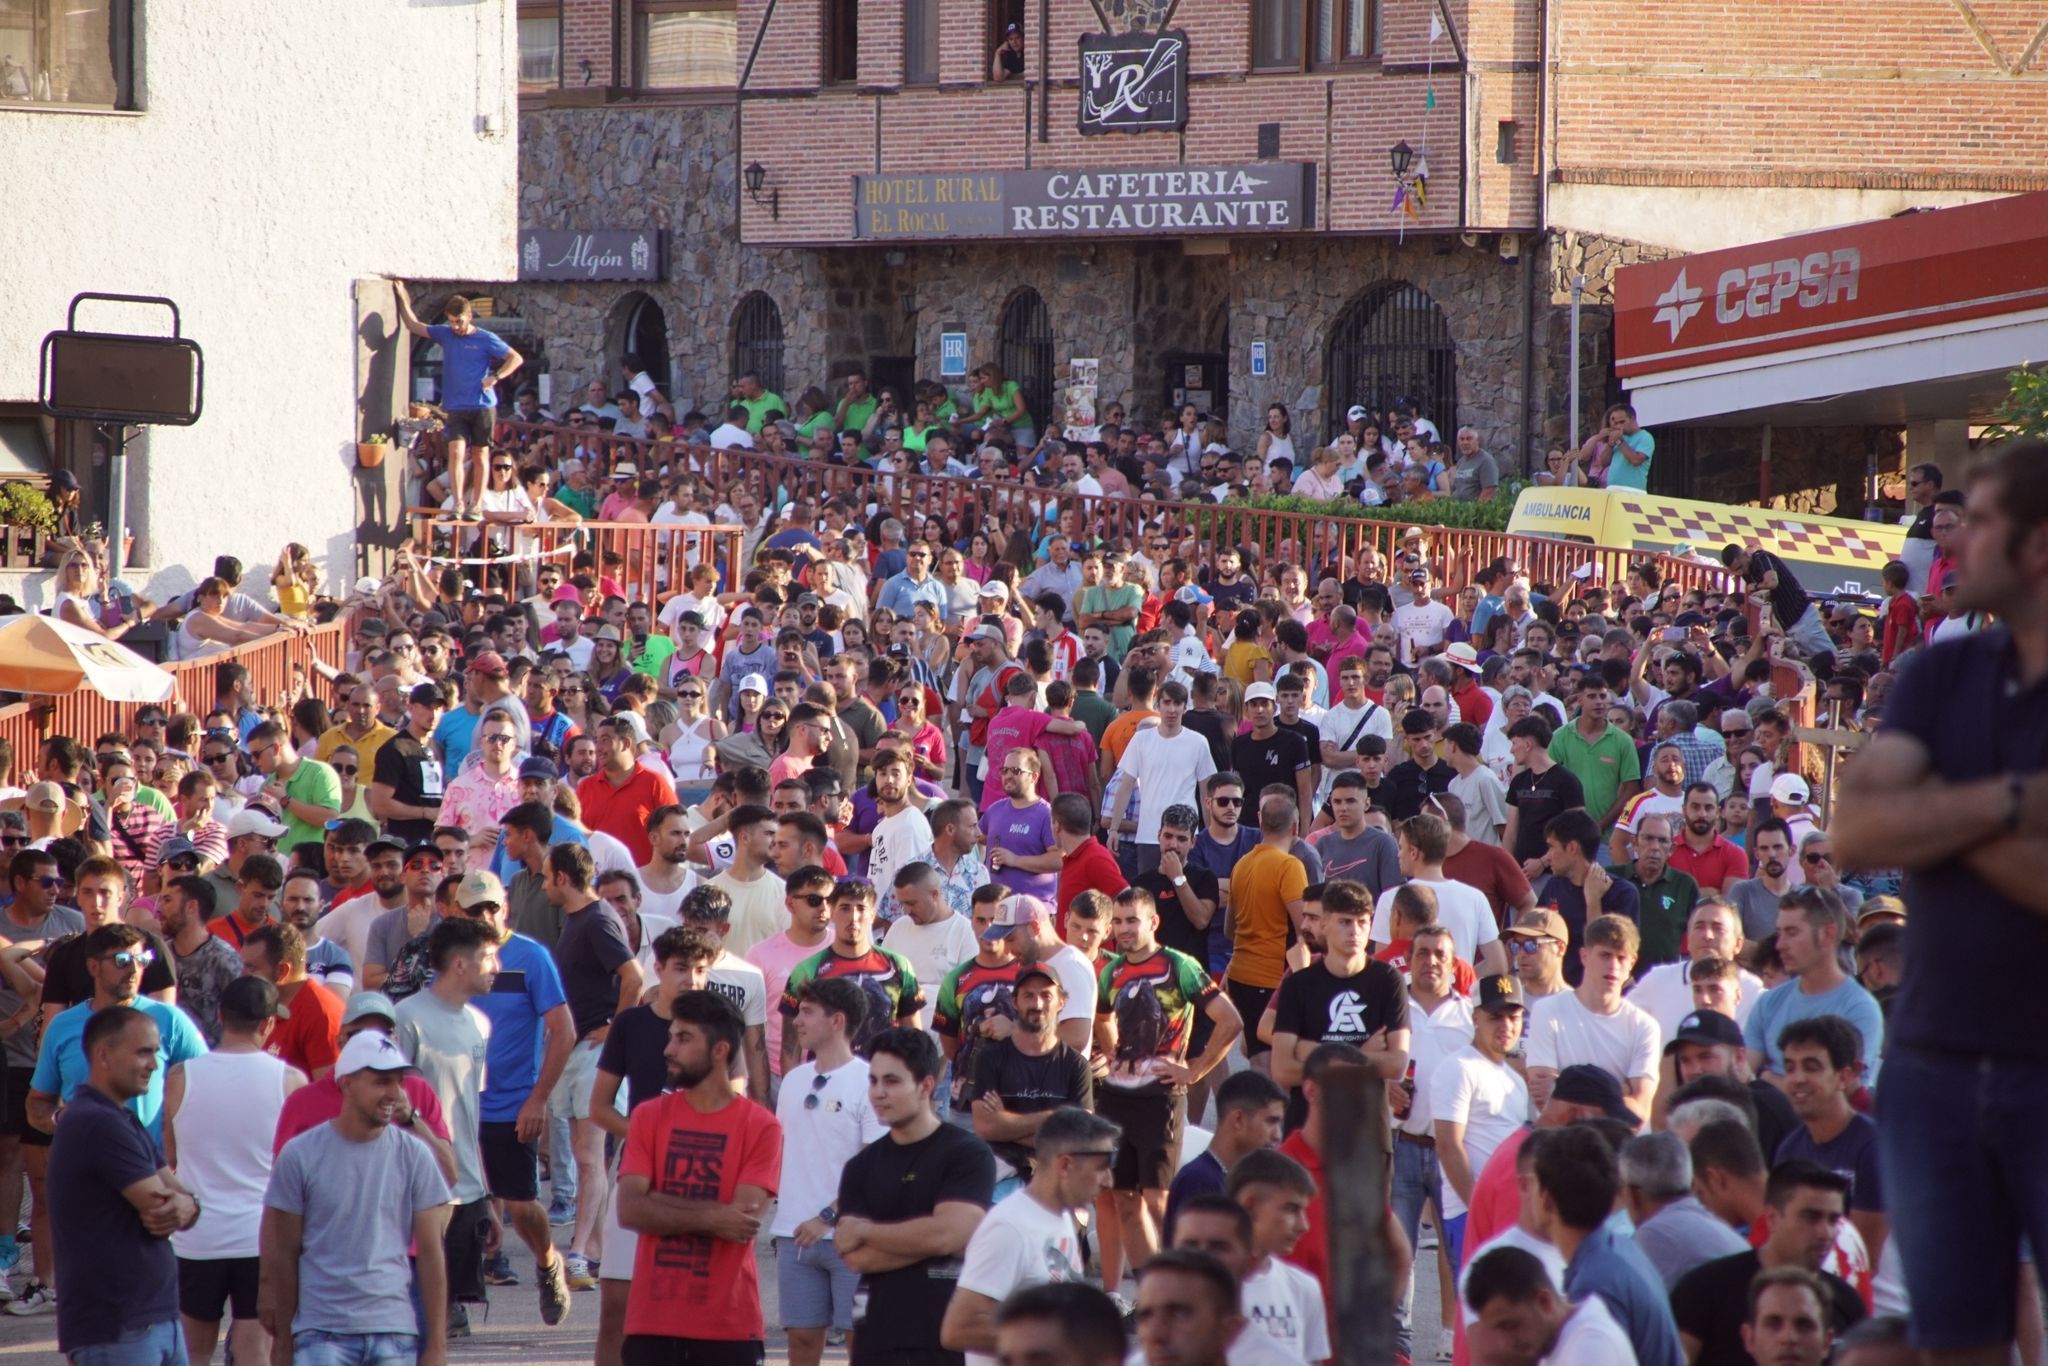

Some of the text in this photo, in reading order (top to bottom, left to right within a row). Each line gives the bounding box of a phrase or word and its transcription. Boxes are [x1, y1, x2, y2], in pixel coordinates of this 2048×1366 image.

[865, 176, 1000, 205] HOTEL RURAL
[1047, 170, 1254, 199] CAFETERIA
[1012, 200, 1290, 231] RESTAURANTE
[547, 235, 622, 277] Algón
[1716, 248, 1860, 324] CEPSA
[945, 340, 963, 357] HR
[1522, 502, 1591, 521] AMBULANCIA
